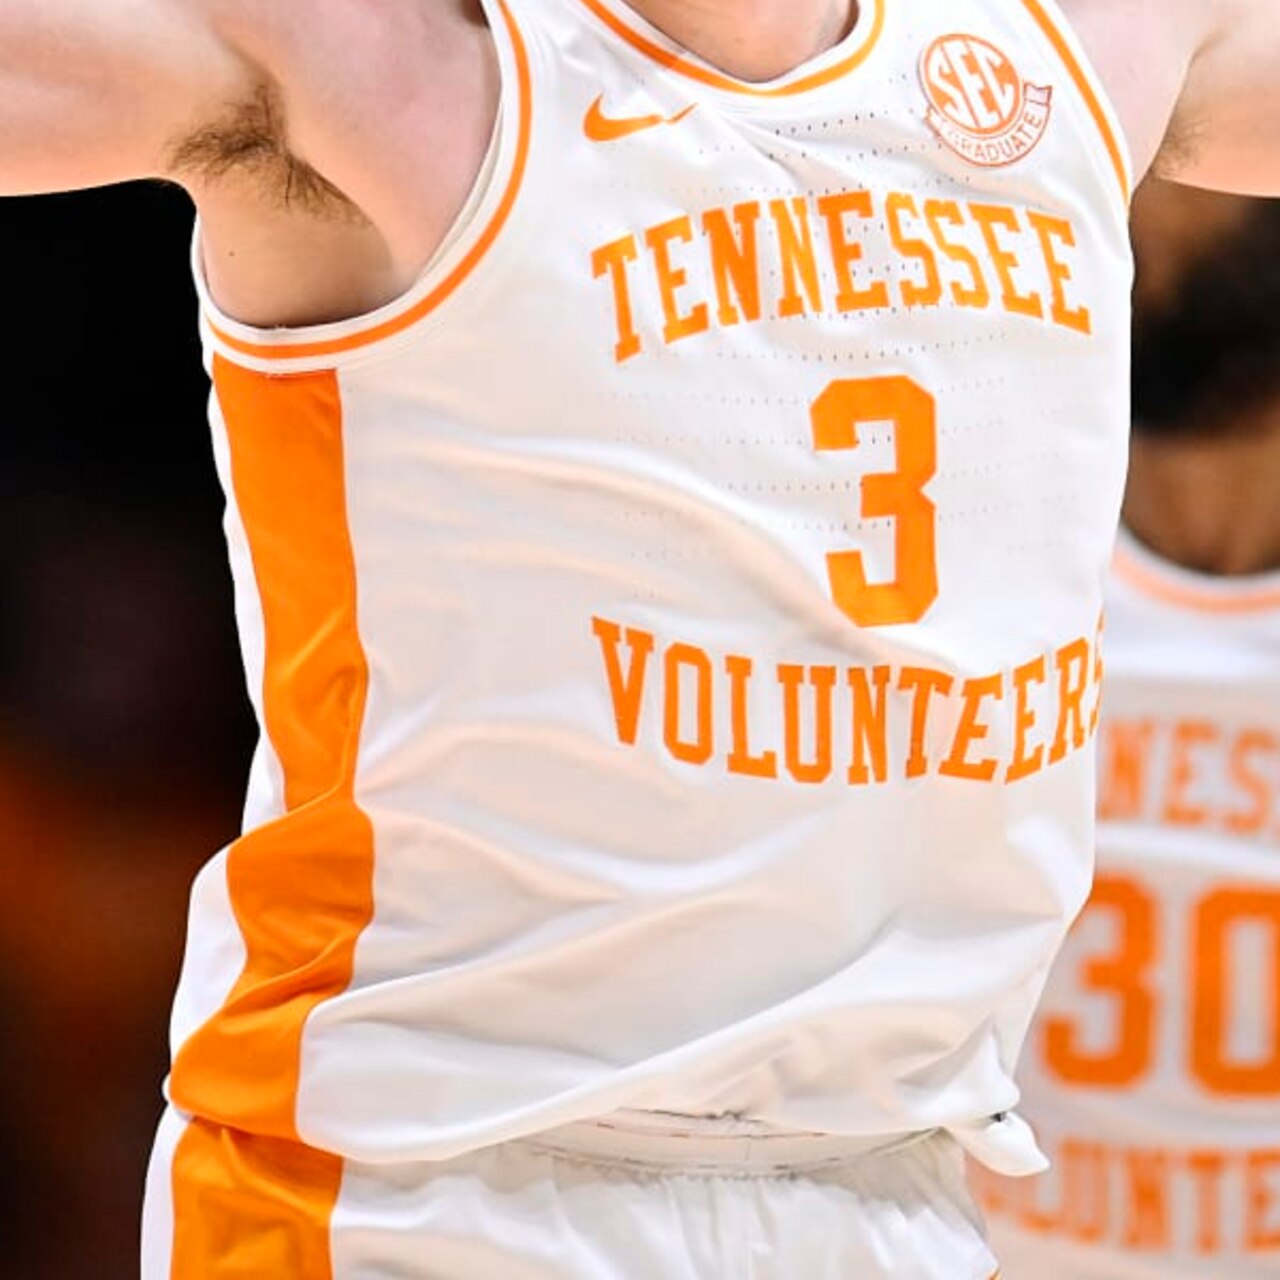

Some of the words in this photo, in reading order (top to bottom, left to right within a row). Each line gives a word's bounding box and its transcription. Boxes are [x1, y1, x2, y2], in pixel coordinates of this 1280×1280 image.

[927, 38, 1016, 128] SEC
[590, 189, 1092, 363] TENNESSEE
[809, 374, 939, 628] 3
